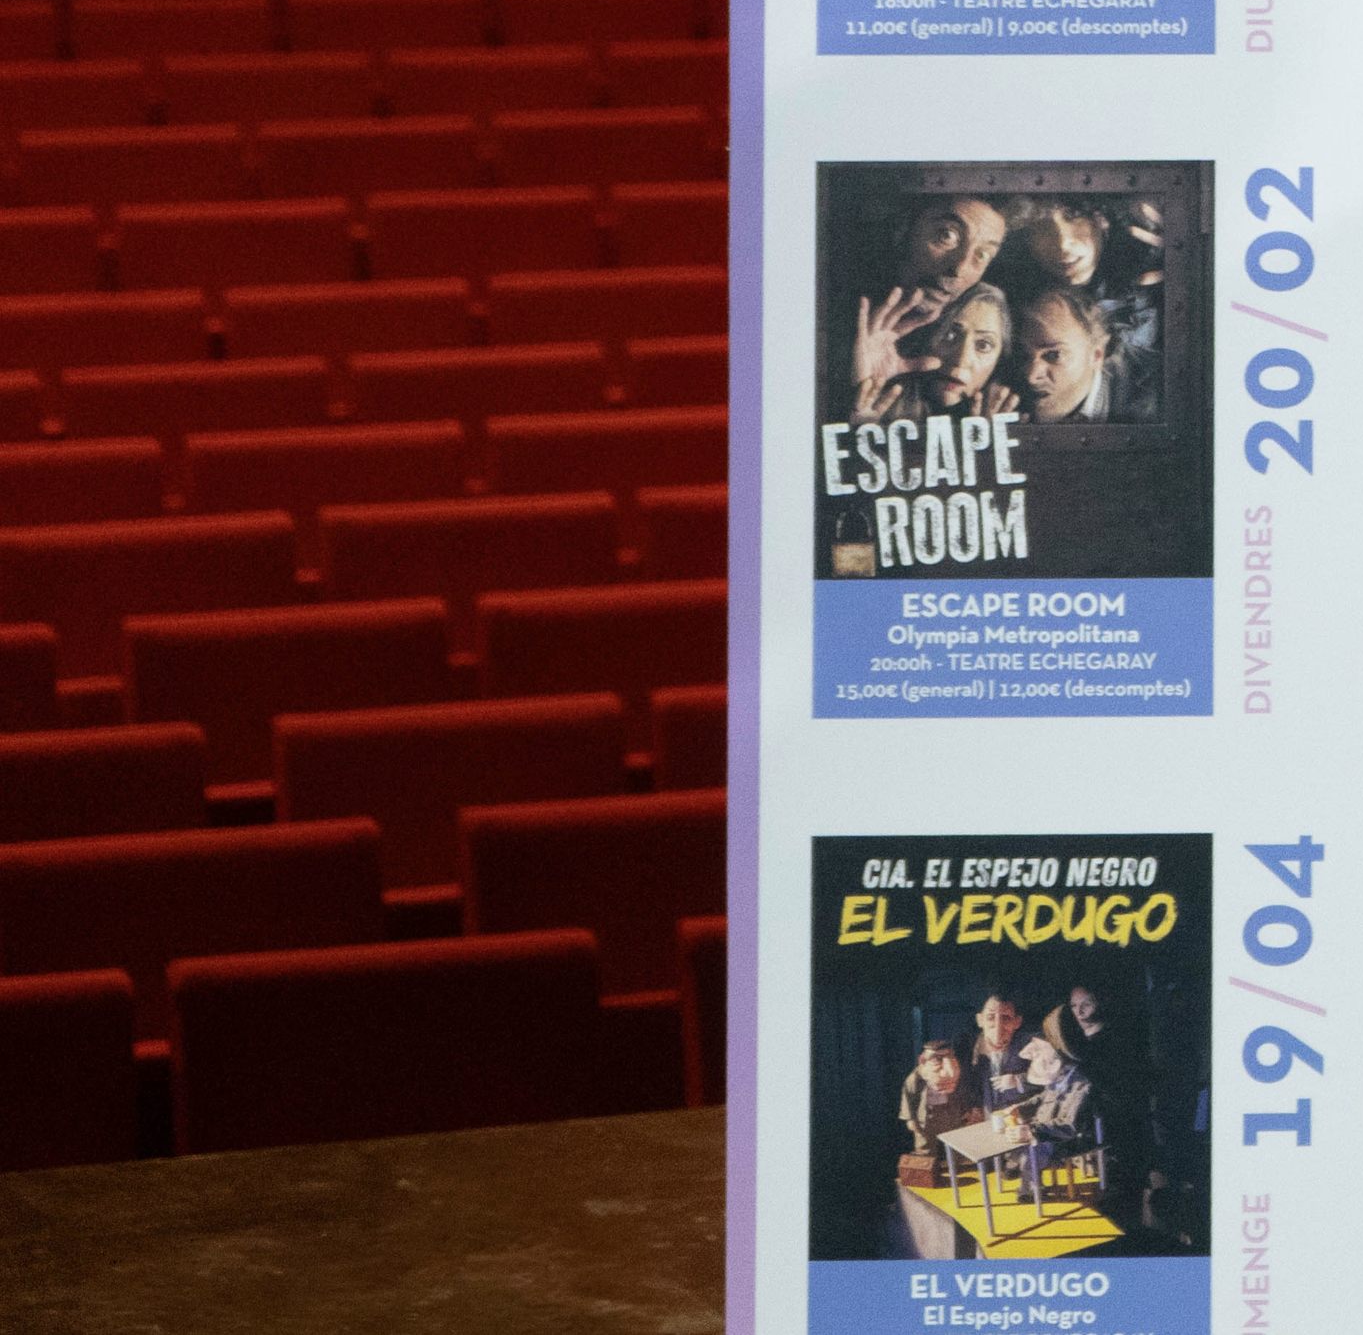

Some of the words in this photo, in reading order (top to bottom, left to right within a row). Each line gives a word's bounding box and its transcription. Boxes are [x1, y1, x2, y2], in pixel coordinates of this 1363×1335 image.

[1230, 166, 1329, 477] 20/02
[820, 411, 1028, 497] ESCAPE
[873, 488, 1029, 568] ROOM
[902, 592, 1021, 618] ESCAPE
[1027, 591, 1126, 618] ROOM
[1243, 505, 1273, 715] DIVENDRES
[887, 624, 980, 650] Olympia
[984, 622, 1141, 650] Metropolitana
[862, 858, 915, 889] CIA.
[923, 858, 952, 889] EL
[959, 857, 1060, 888] ESPEJO
[1065, 856, 1158, 888] NEGRO
[837, 894, 913, 947] EL
[923, 892, 1178, 950] VERDUGO
[1228, 834, 1327, 1147] 19/04
[910, 1273, 948, 1299] EL
[954, 1271, 1110, 1299] VERDUGO
[923, 1304, 945, 1326] El
[949, 1304, 1024, 1330] Espejo
[1028, 1304, 1097, 1330] Negro
